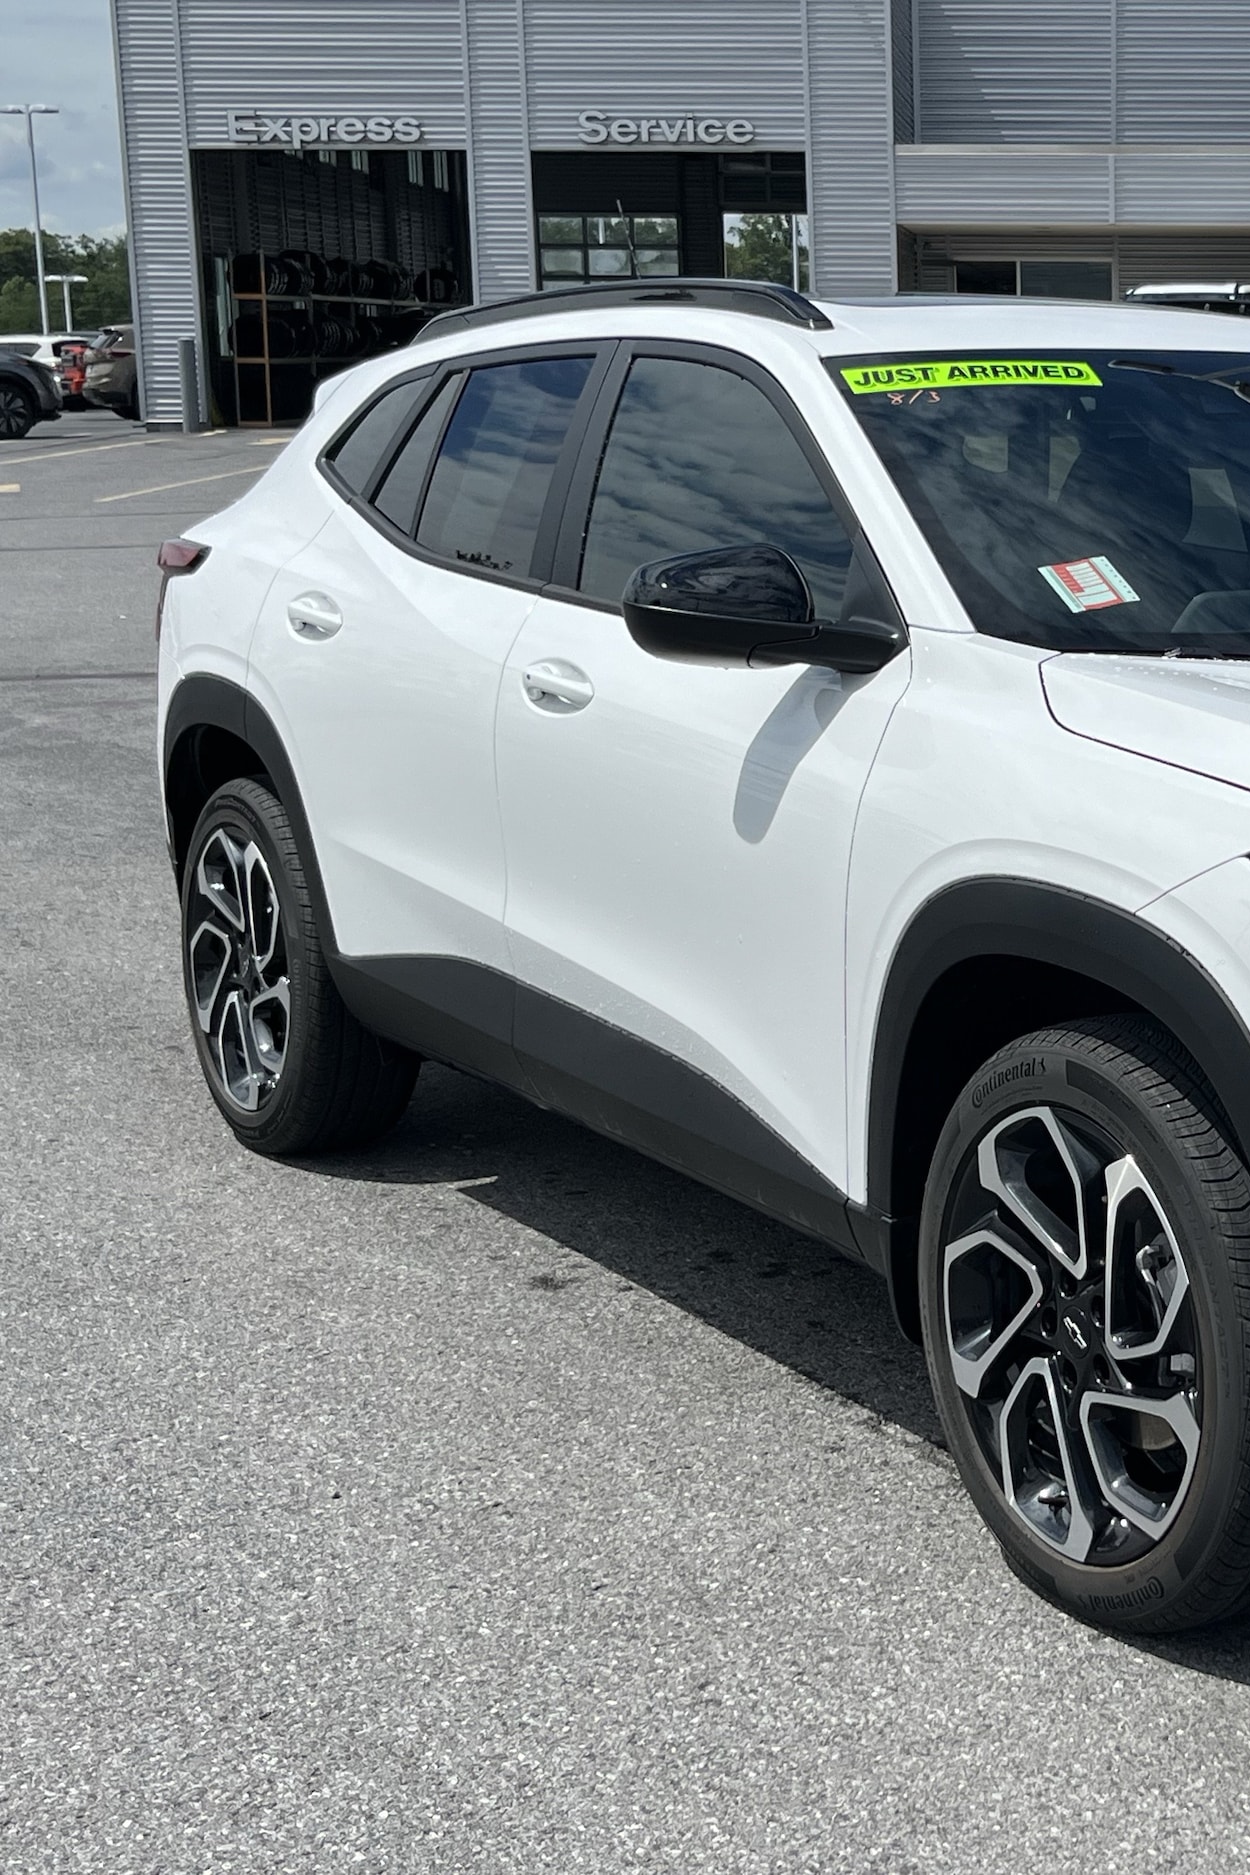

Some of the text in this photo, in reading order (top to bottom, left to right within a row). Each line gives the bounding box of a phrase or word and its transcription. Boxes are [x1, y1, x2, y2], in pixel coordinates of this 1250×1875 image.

[226, 109, 421, 149] Express
[577, 110, 755, 144] Service
[854, 364, 1087, 387] JUST ARRIVED
[972, 1057, 1037, 1109] Continental
[1088, 1575, 1165, 1612] Continental
